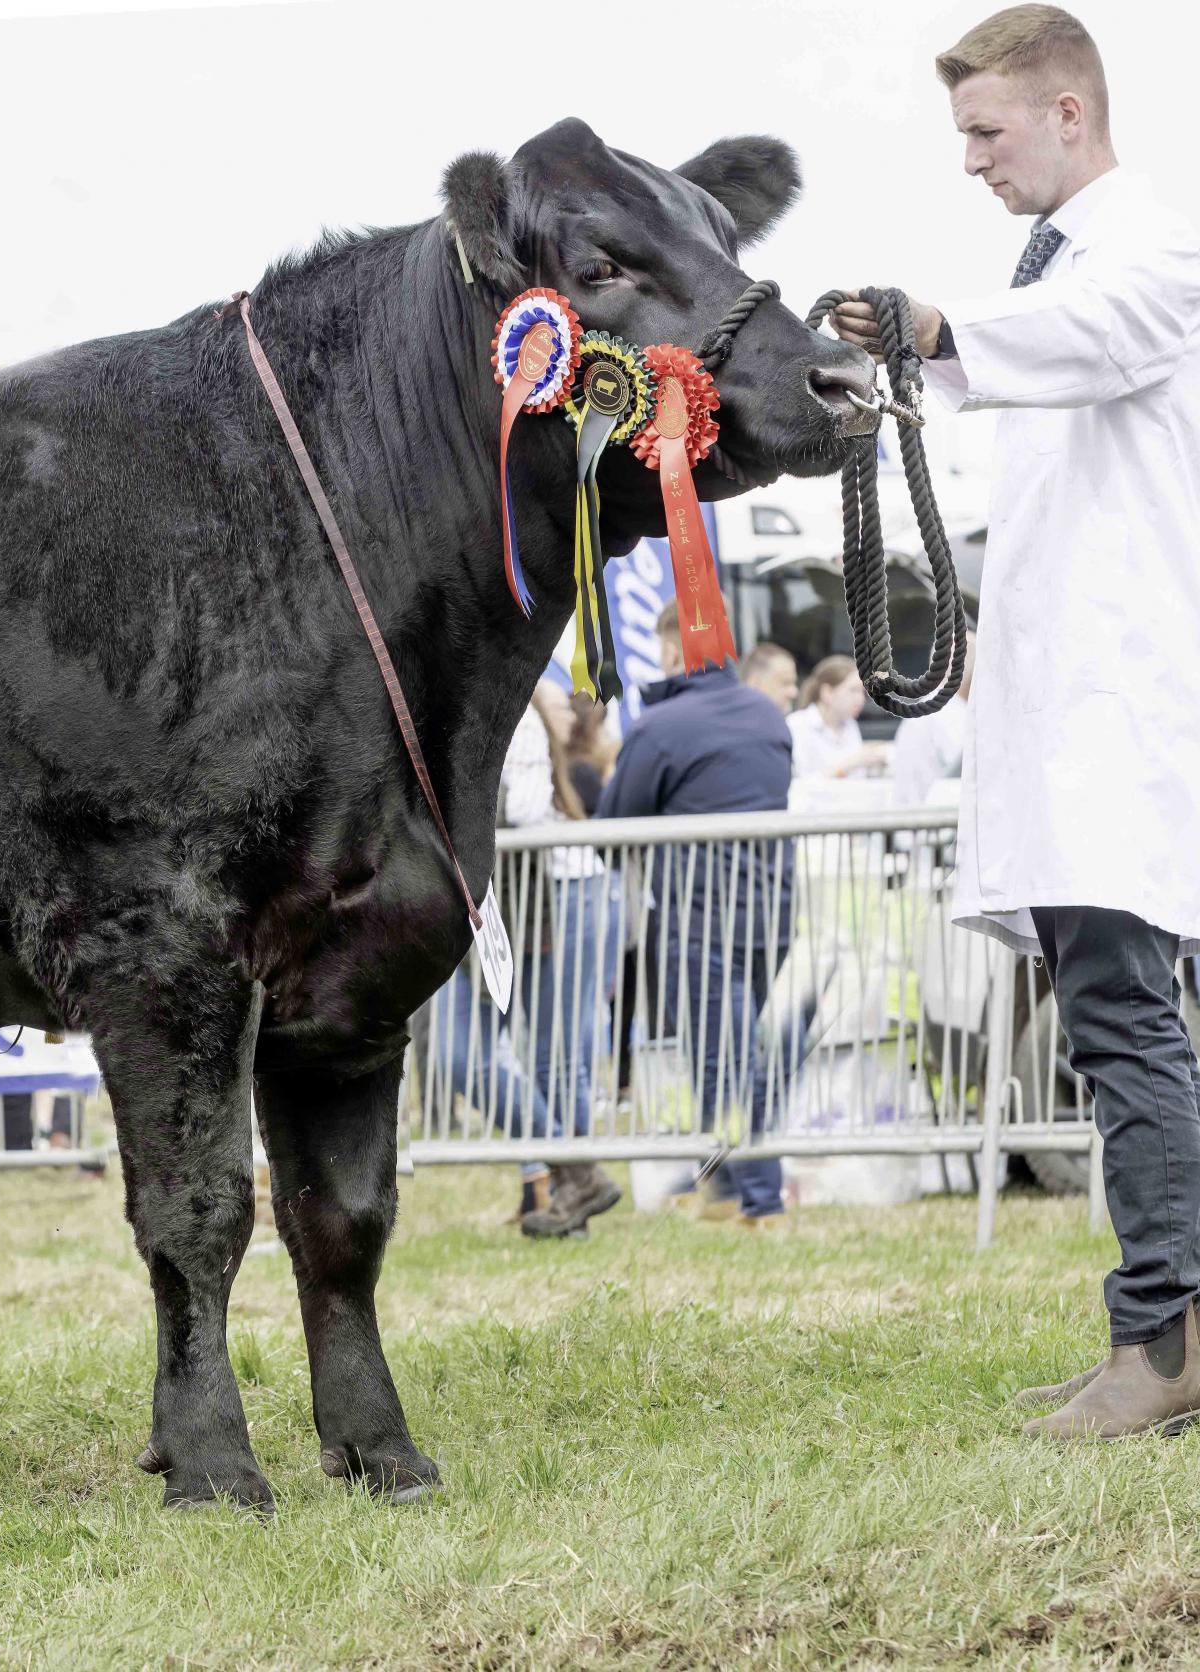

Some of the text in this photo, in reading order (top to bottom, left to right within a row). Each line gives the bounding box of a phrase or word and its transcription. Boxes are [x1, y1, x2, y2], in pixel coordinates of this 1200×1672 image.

[669, 471, 700, 593] NEW DEER SHOW
